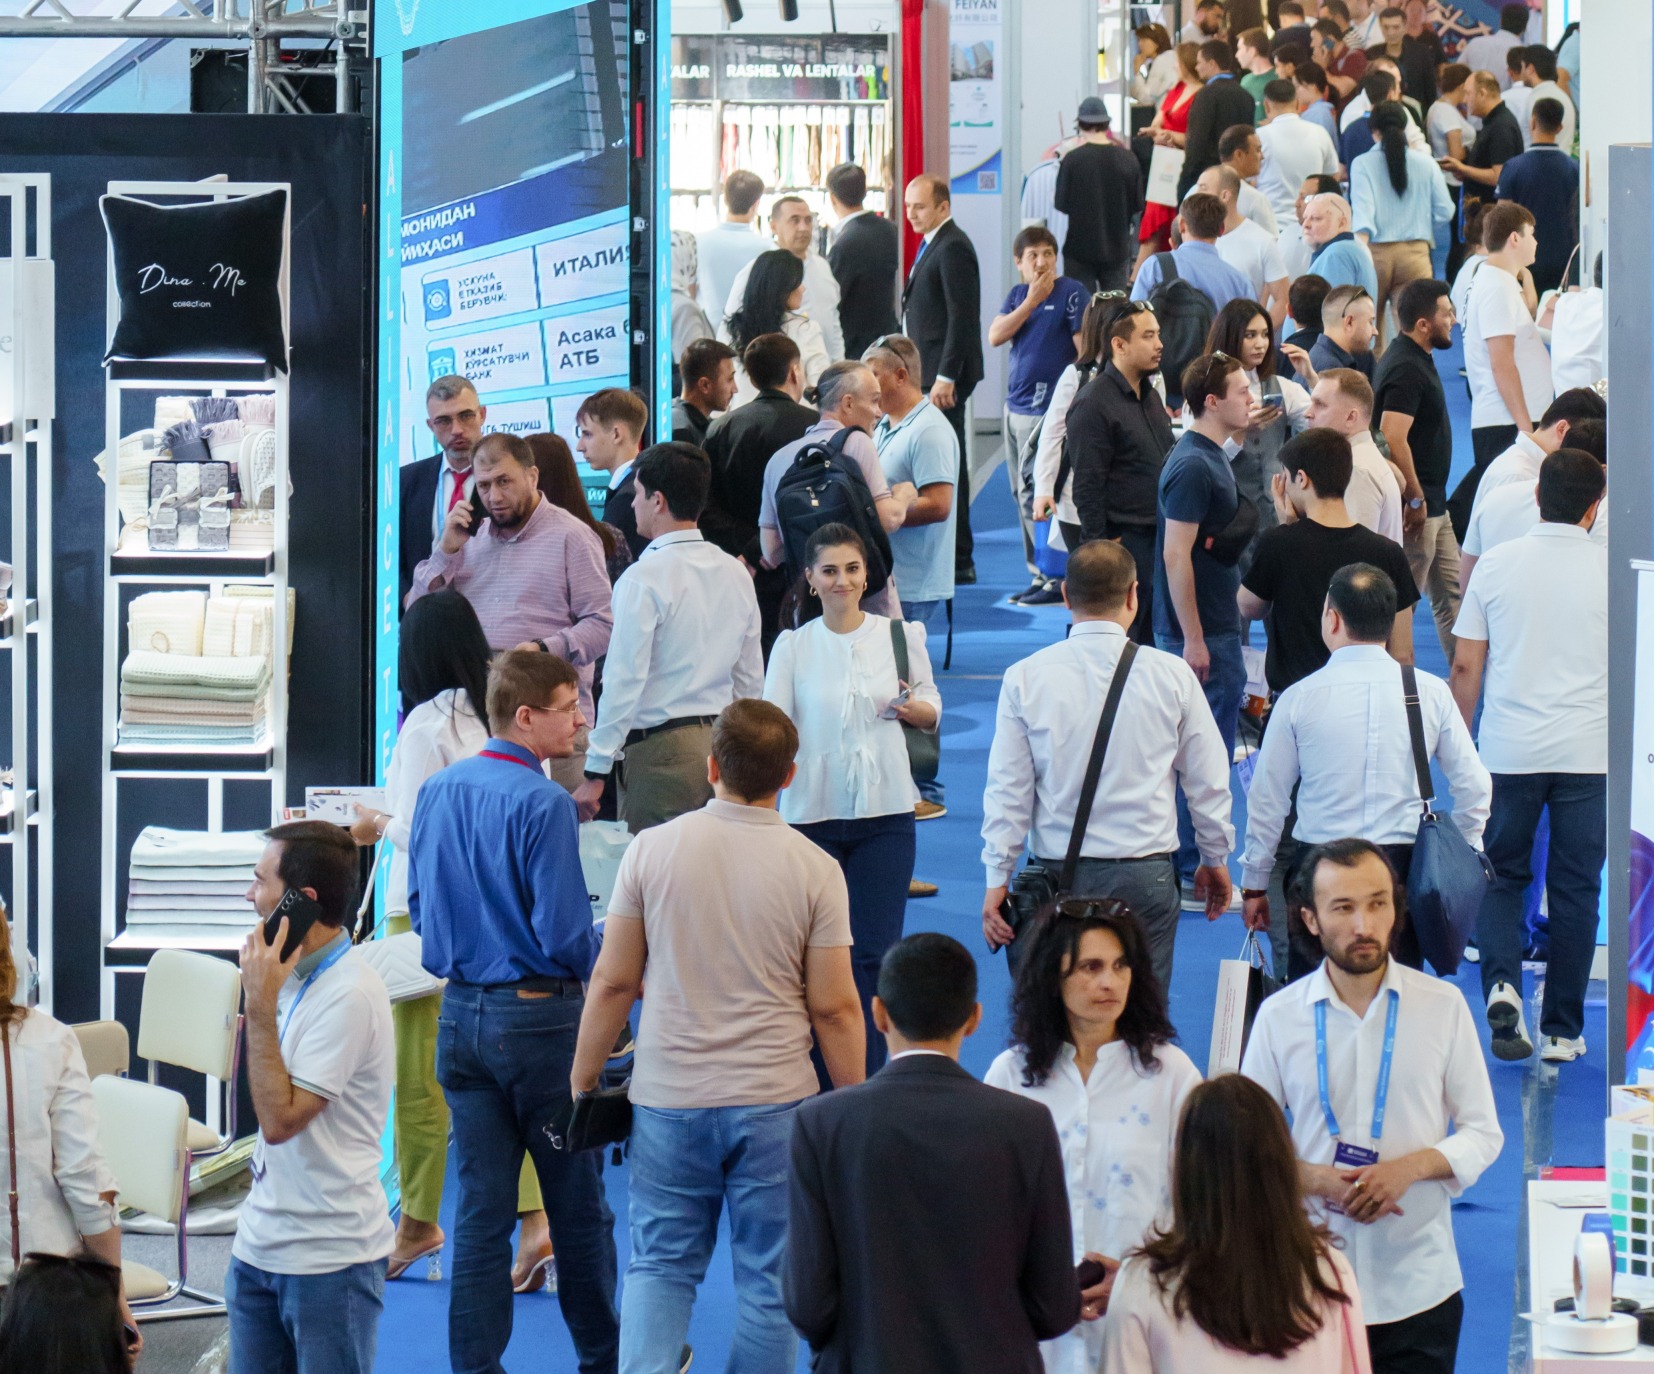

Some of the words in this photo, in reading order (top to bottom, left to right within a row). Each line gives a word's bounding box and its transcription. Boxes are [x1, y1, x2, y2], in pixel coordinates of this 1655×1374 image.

[955, 0, 997, 9] FEIYAN
[670, 65, 710, 79] ALAR
[726, 64, 780, 78] RASHEL
[782, 64, 803, 78] VA
[805, 64, 876, 78] LENTALAR
[137, 262, 193, 295] Dina
[208, 262, 247, 297] Me
[557, 325, 617, 347] Асака
[560, 348, 600, 370] АТБ
[382, 149, 396, 636] ALLIANCE
